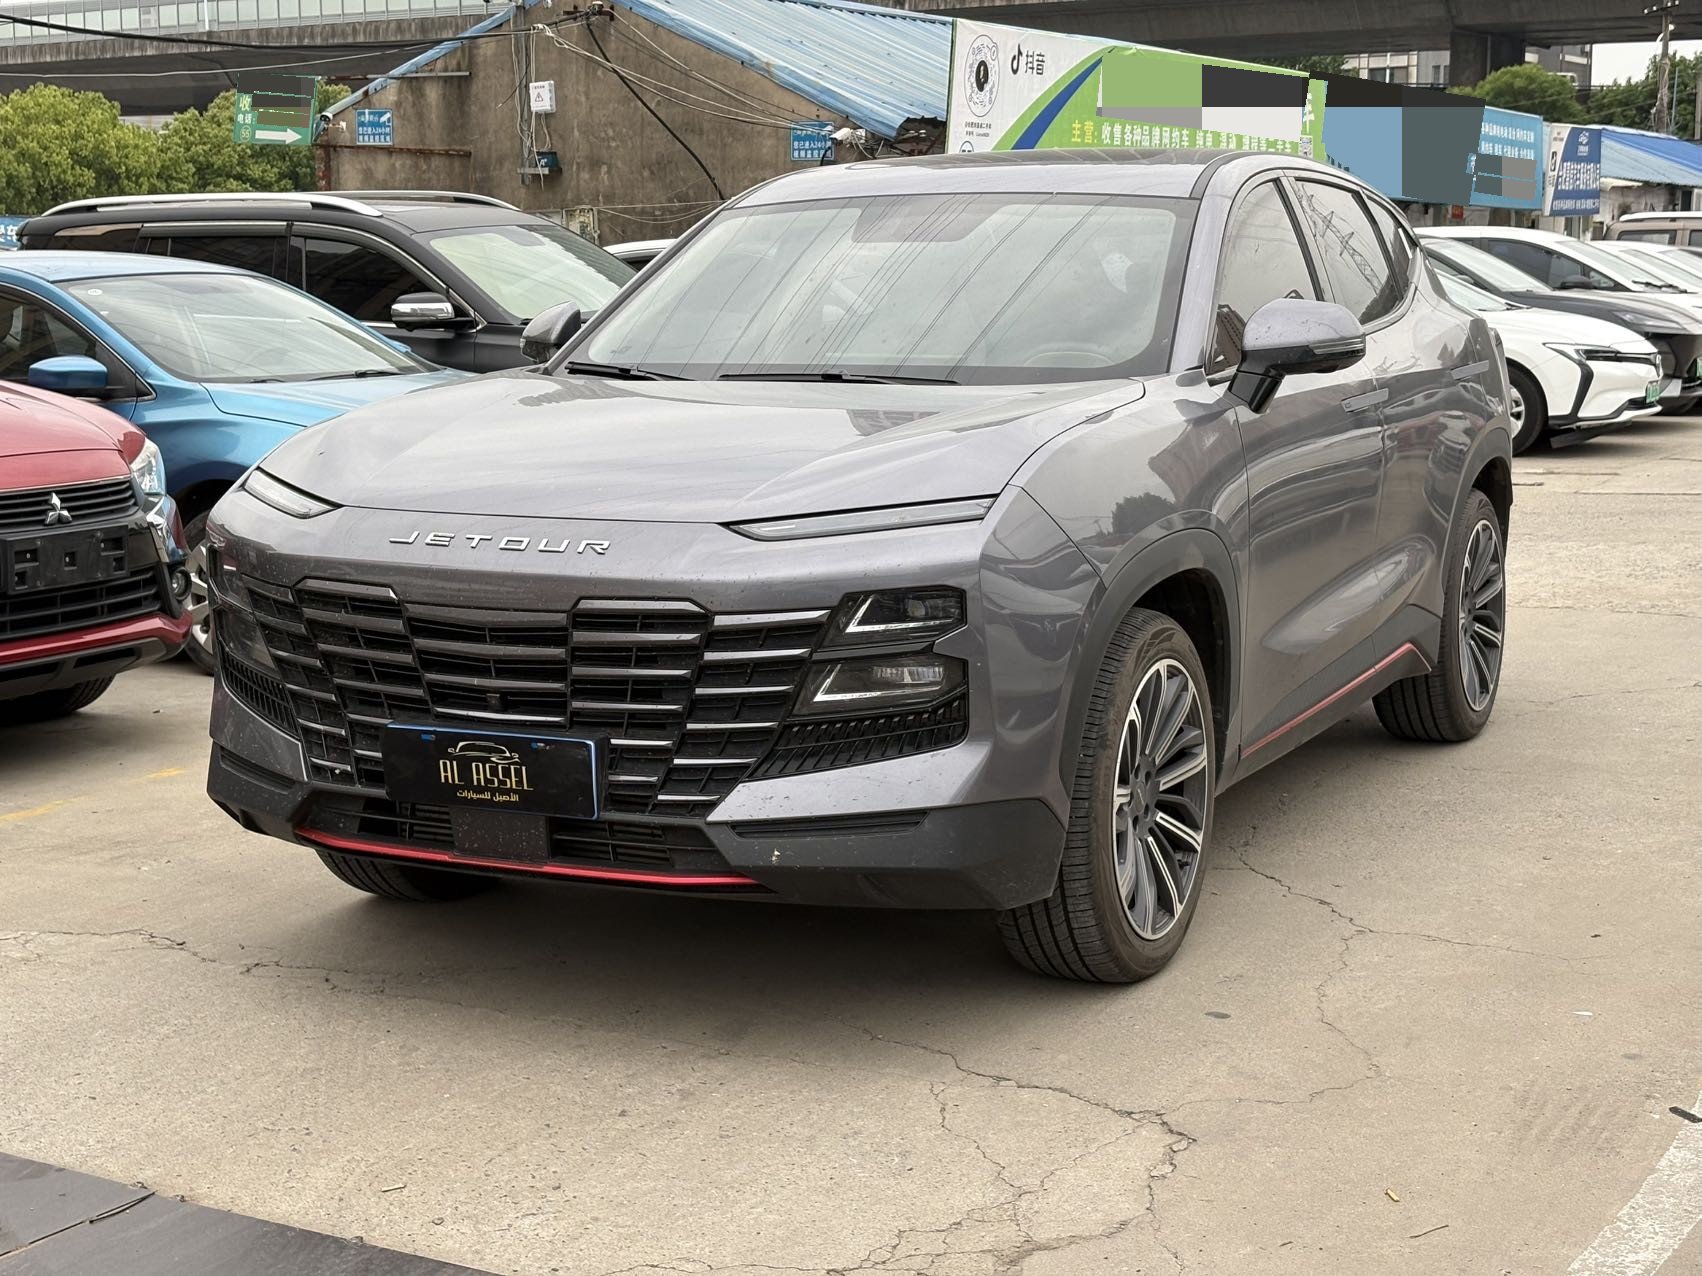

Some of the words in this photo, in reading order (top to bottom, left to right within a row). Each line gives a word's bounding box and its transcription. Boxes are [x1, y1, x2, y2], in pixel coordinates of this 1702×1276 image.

[1024, 50, 1046, 76] 抖音
[239, 95, 252, 111] 收
[389, 530, 612, 555] JETOUR
[439, 759, 465, 785] AL
[471, 762, 534, 791] ASSEL
[456, 789, 491, 800] للسيارات
[493, 792, 520, 802] الأصيل
